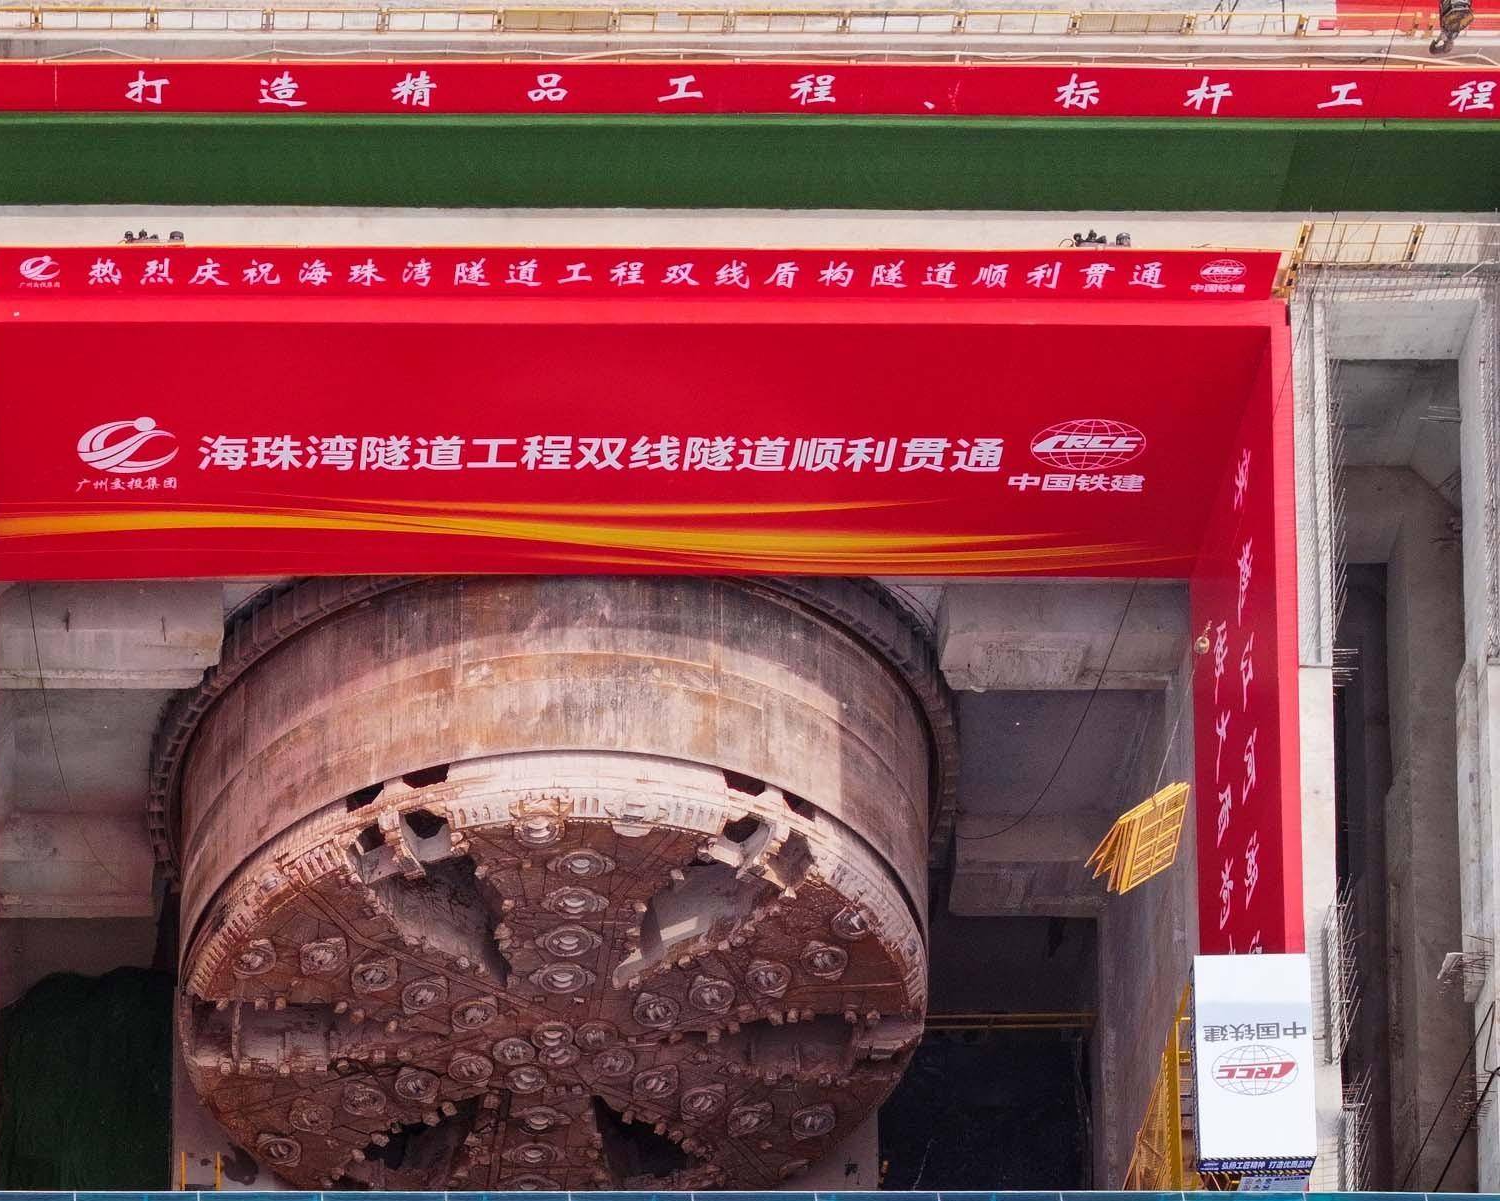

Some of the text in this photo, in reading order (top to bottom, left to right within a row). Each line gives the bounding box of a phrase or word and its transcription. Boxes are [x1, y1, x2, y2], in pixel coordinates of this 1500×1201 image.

[88, 257, 1166, 289] 热烈庆祝海珠湾隧道工程双线盾构隧道顺利贯通
[198, 434, 1004, 473] 海珠湾隧道工程双线隧道顺利贯通
[1007, 473, 1146, 492] 中国铁建
[1203, 1021, 1308, 1042] 中国铁建
